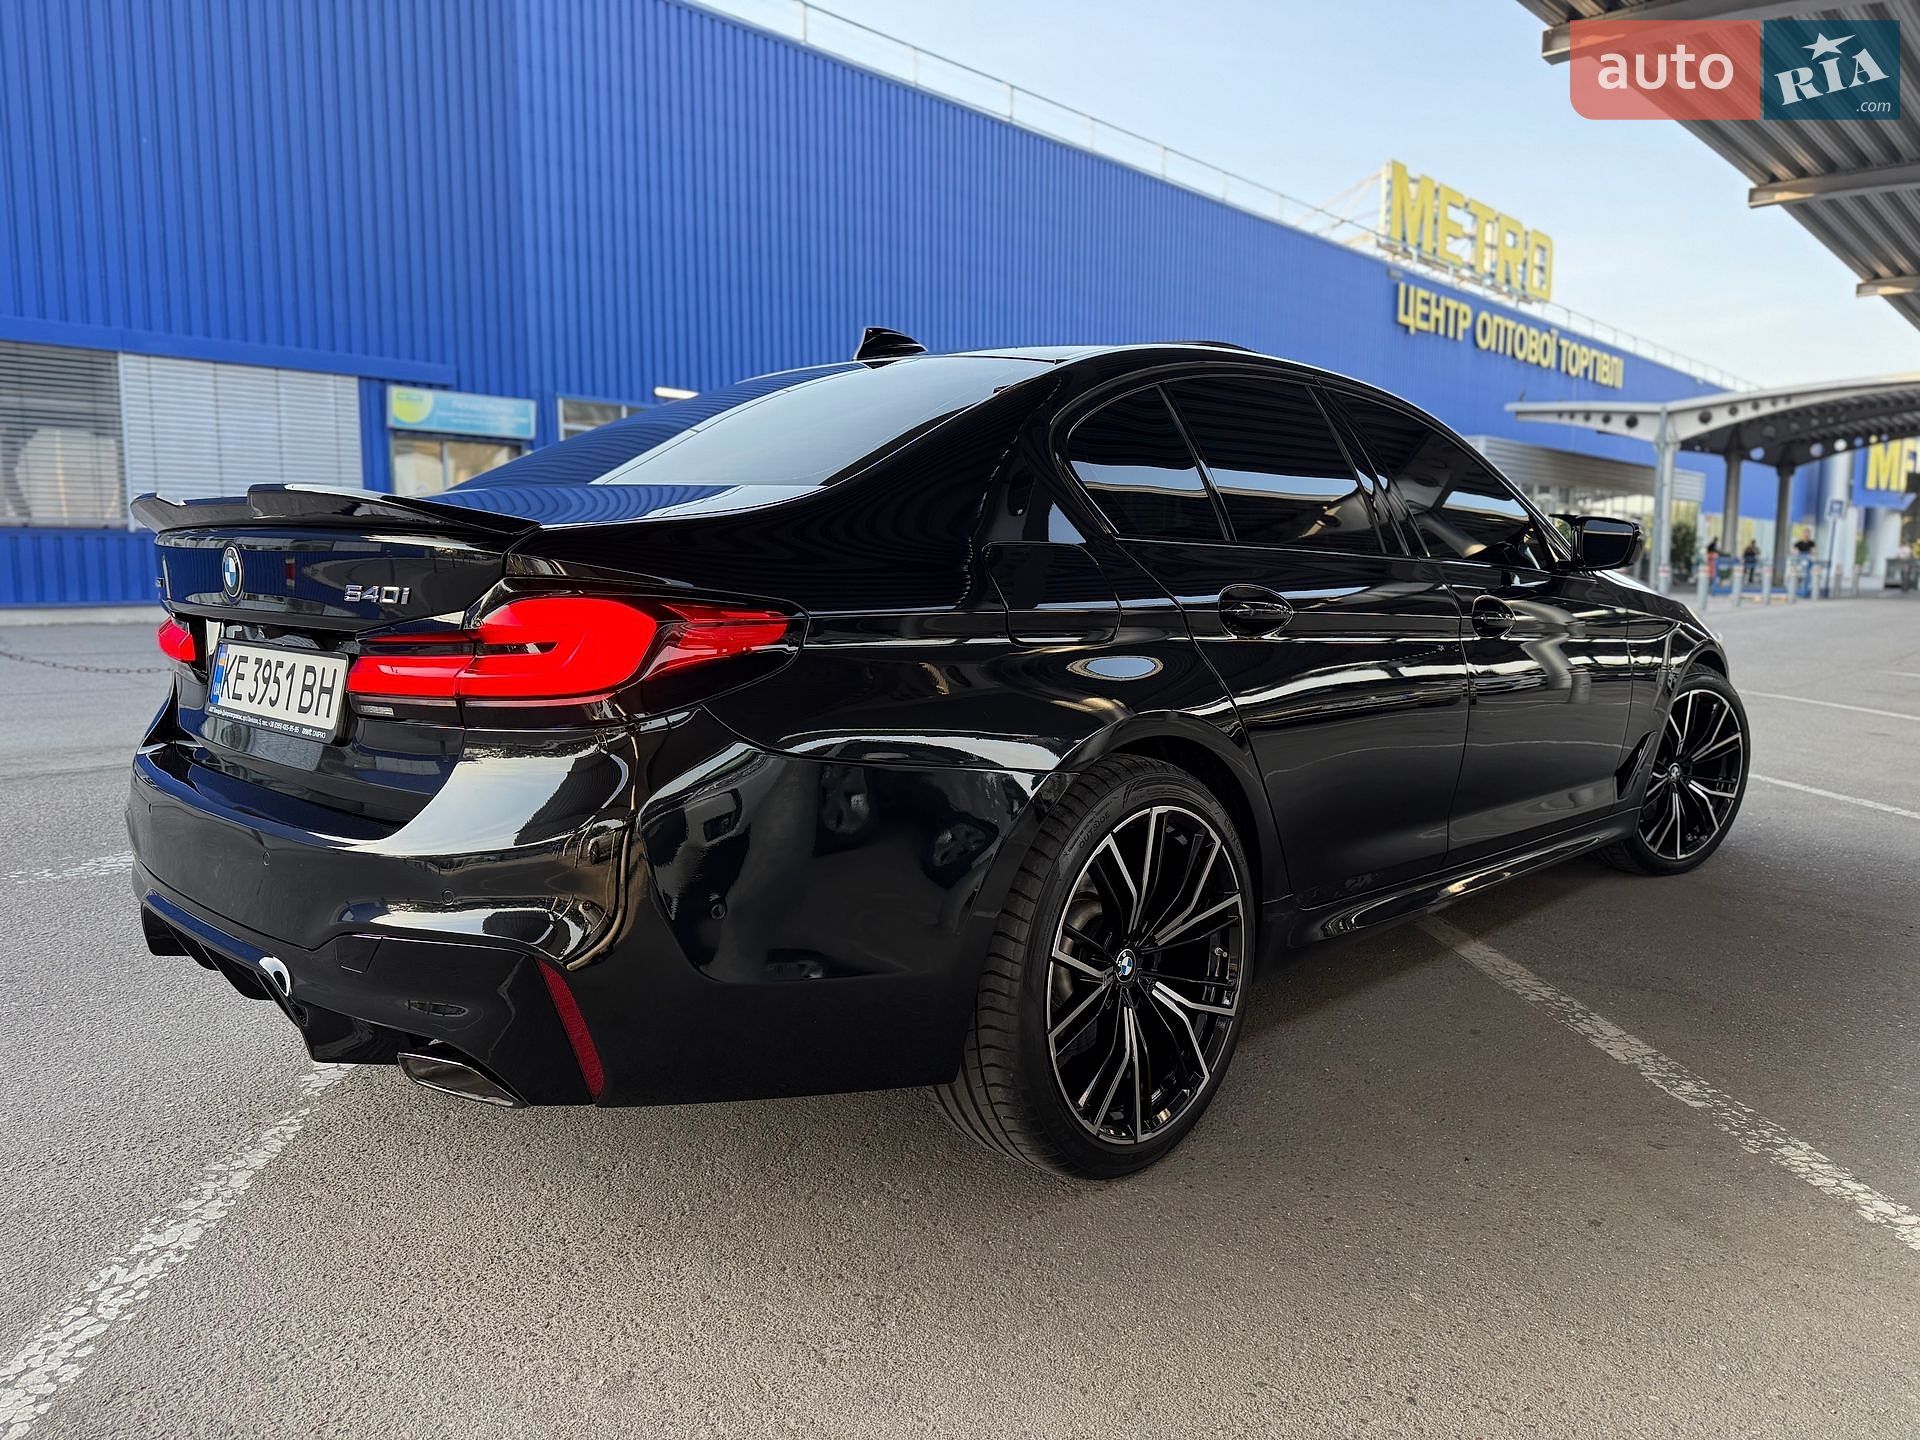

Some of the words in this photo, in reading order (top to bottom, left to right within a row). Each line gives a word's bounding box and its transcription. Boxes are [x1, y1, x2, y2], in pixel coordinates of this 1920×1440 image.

[1389, 160, 1552, 303] METRO
[1397, 281, 1472, 341] ЦЕНТР
[1475, 310, 1557, 370] ОПТОВОЇ
[343, 584, 410, 605] 540i
[221, 654, 248, 701] KE
[248, 657, 297, 711] 3951
[297, 664, 337, 719] BH
